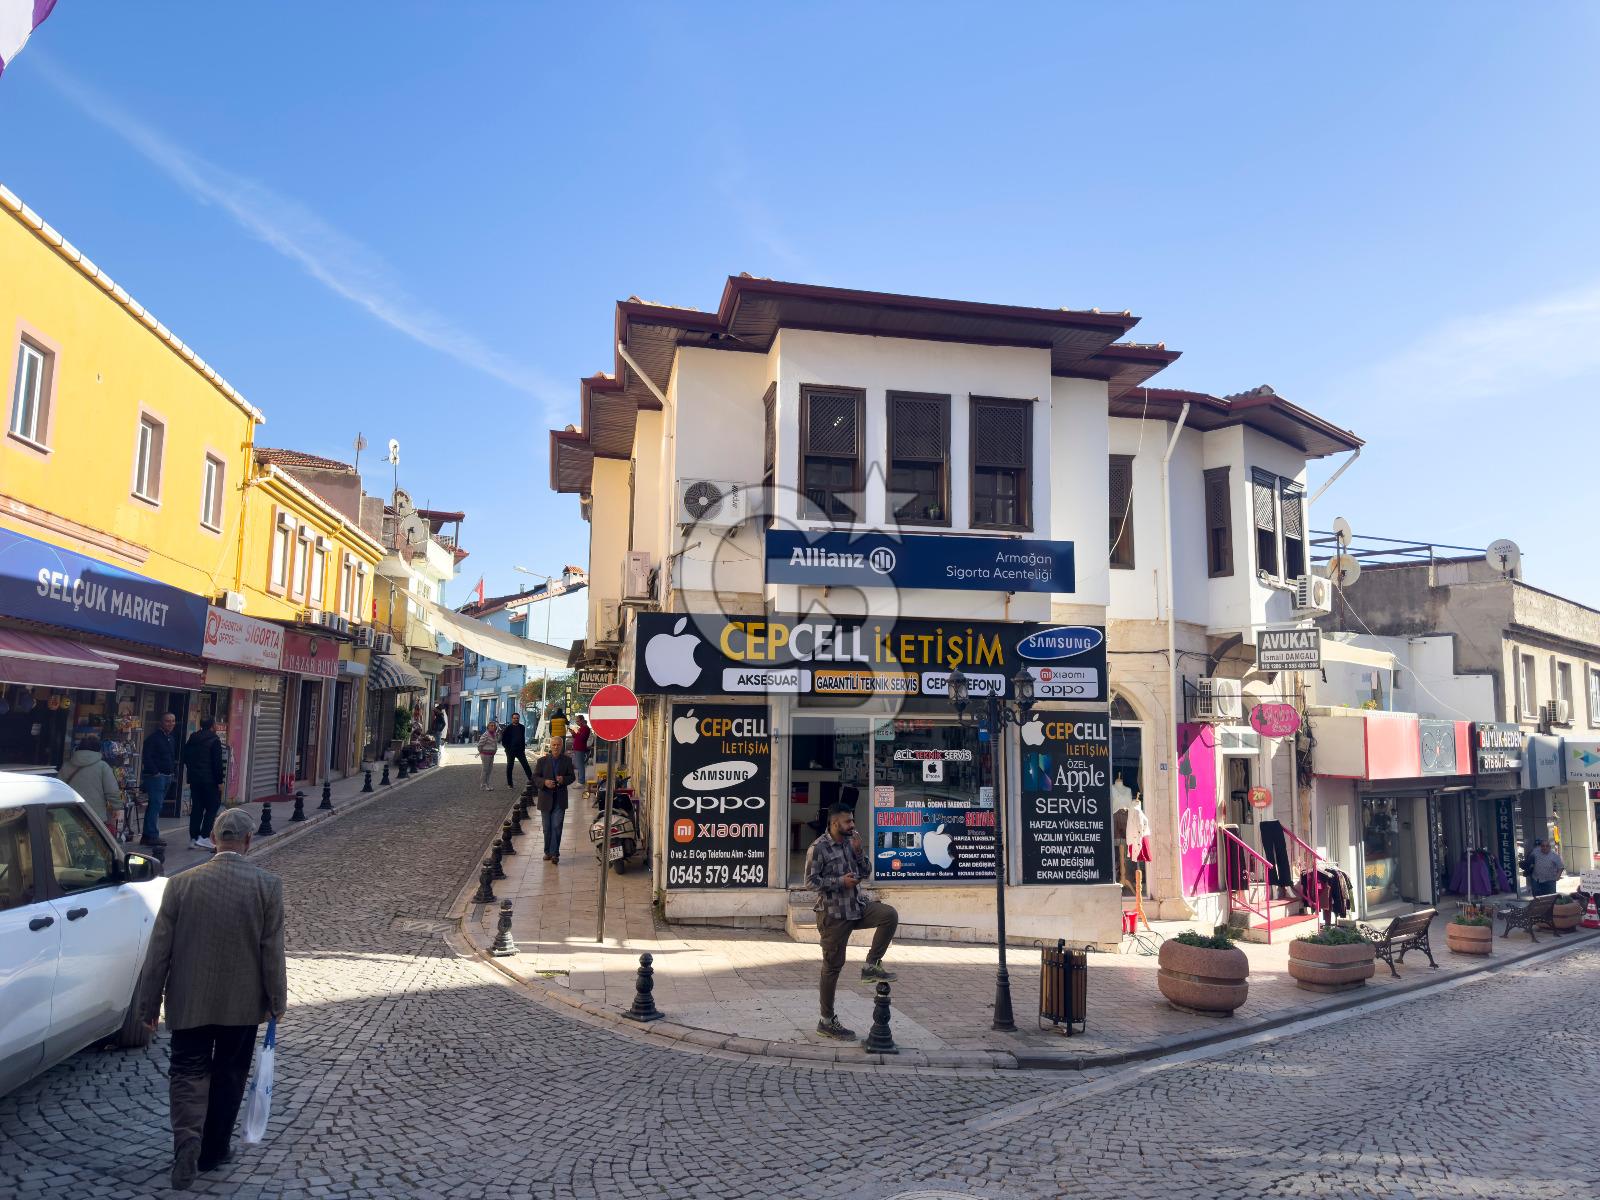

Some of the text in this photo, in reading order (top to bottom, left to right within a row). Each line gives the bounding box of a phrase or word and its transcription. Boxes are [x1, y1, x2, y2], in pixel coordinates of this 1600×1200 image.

[789, 546, 864, 568] Allianz
[995, 551, 1052, 567] Armağan
[946, 565, 1052, 583] Sigorta Acenteliği
[36, 567, 169, 627] SELÇUK MARKET
[719, 621, 1005, 670] CEPCELL İLETİŞİM
[1029, 635, 1092, 650] SAMSUNG
[1262, 631, 1317, 649] AVUKAT
[737, 674, 798, 686] AKSESUAR
[816, 673, 918, 692] GARANTİLİ TEKNİK SERVİS
[1052, 671, 1085, 679] xiaomi
[926, 677, 947, 690] CEP
[1041, 685, 1084, 696] oppo
[700, 718, 768, 737] CEPCELL
[1045, 722, 1107, 741] CEPCELL
[721, 741, 769, 756] İLETİŞİM
[895, 748, 971, 760] ACİL TEKNİK SERVİS
[1066, 742, 1109, 757] İLETİŞİM
[1067, 759, 1088, 769] ÖZEL
[692, 770, 749, 781] SAMSUNG
[1054, 763, 1105, 793] Apple
[673, 796, 765, 814] oppo
[906, 800, 926, 808] FATURA
[1035, 795, 1098, 814] SERVİS
[697, 823, 764, 838] xiaomi
[1030, 819, 1104, 829] HAFIZA YÜKSELTME
[1033, 832, 1101, 842] YAZILIM YÜKLEME
[695, 850, 707, 860] Cep
[708, 850, 731, 858] Telefonu
[1040, 845, 1095, 854] FORMAT ATMA
[1041, 857, 1095, 868] CAM DEĞİŞİMİ
[669, 865, 764, 884] 0545 579 4549
[1036, 869, 1100, 881] EKRAN DEĞİŞİMİ
